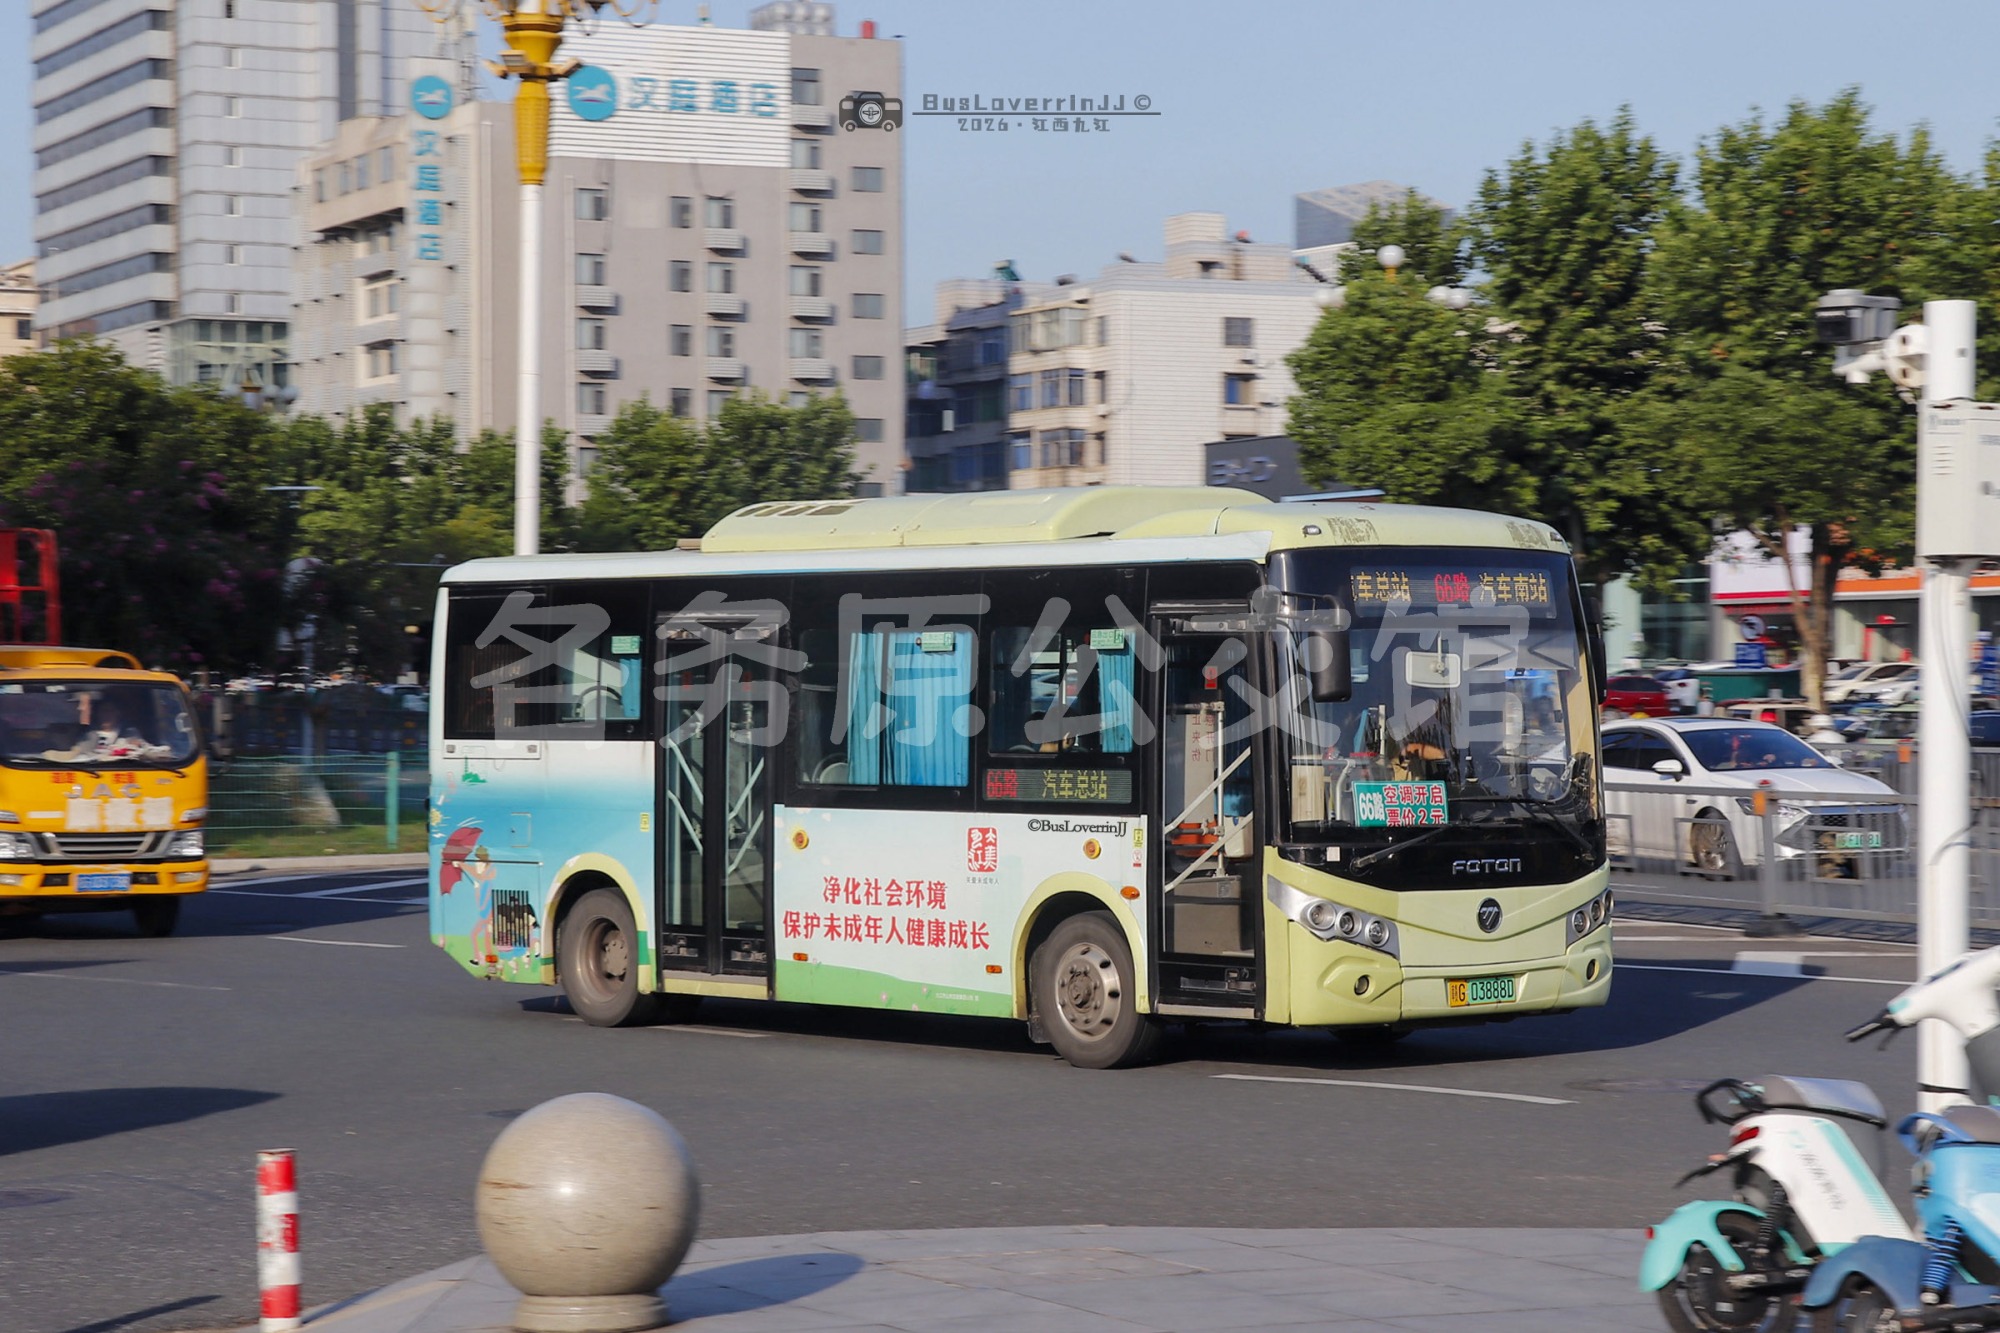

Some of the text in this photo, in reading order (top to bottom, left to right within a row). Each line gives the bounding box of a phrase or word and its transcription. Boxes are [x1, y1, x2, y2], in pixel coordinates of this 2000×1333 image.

[1351, 571, 1548, 603] 车总站 66路 汽车南站
[64, 784, 142, 798] JAC
[1042, 770, 1108, 800] 汽车总站
[1383, 785, 1444, 805] 空调开启
[1359, 792, 1385, 821] 66路
[1452, 858, 1522, 875] FOTON
[822, 876, 947, 910] 净化社会环境
[783, 911, 990, 950] 保护未成年人健康成长
